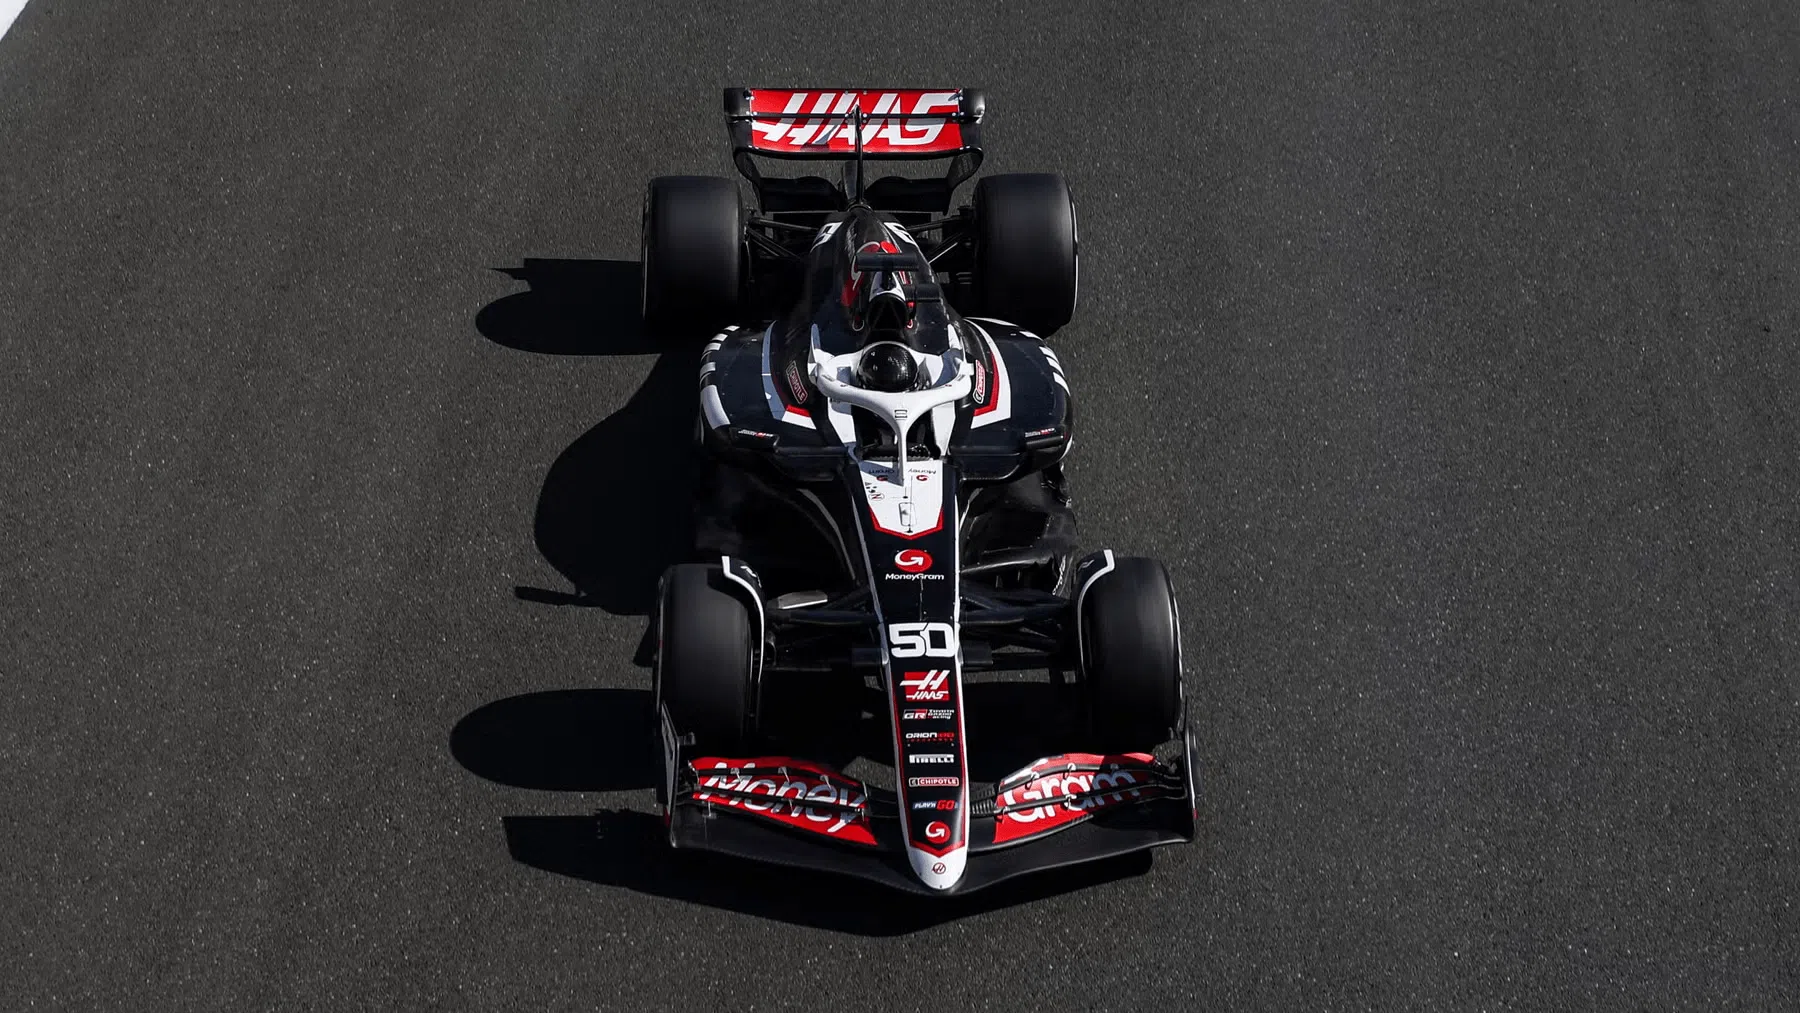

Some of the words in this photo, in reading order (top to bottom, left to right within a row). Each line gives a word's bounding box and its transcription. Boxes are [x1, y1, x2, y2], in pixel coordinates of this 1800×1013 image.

[753, 93, 959, 146] HAAS
[885, 573, 945, 581] MoneyGram
[888, 622, 956, 658] 50
[906, 691, 949, 700] HAAS
[700, 762, 869, 833] Money
[1004, 758, 1141, 823] Gram
